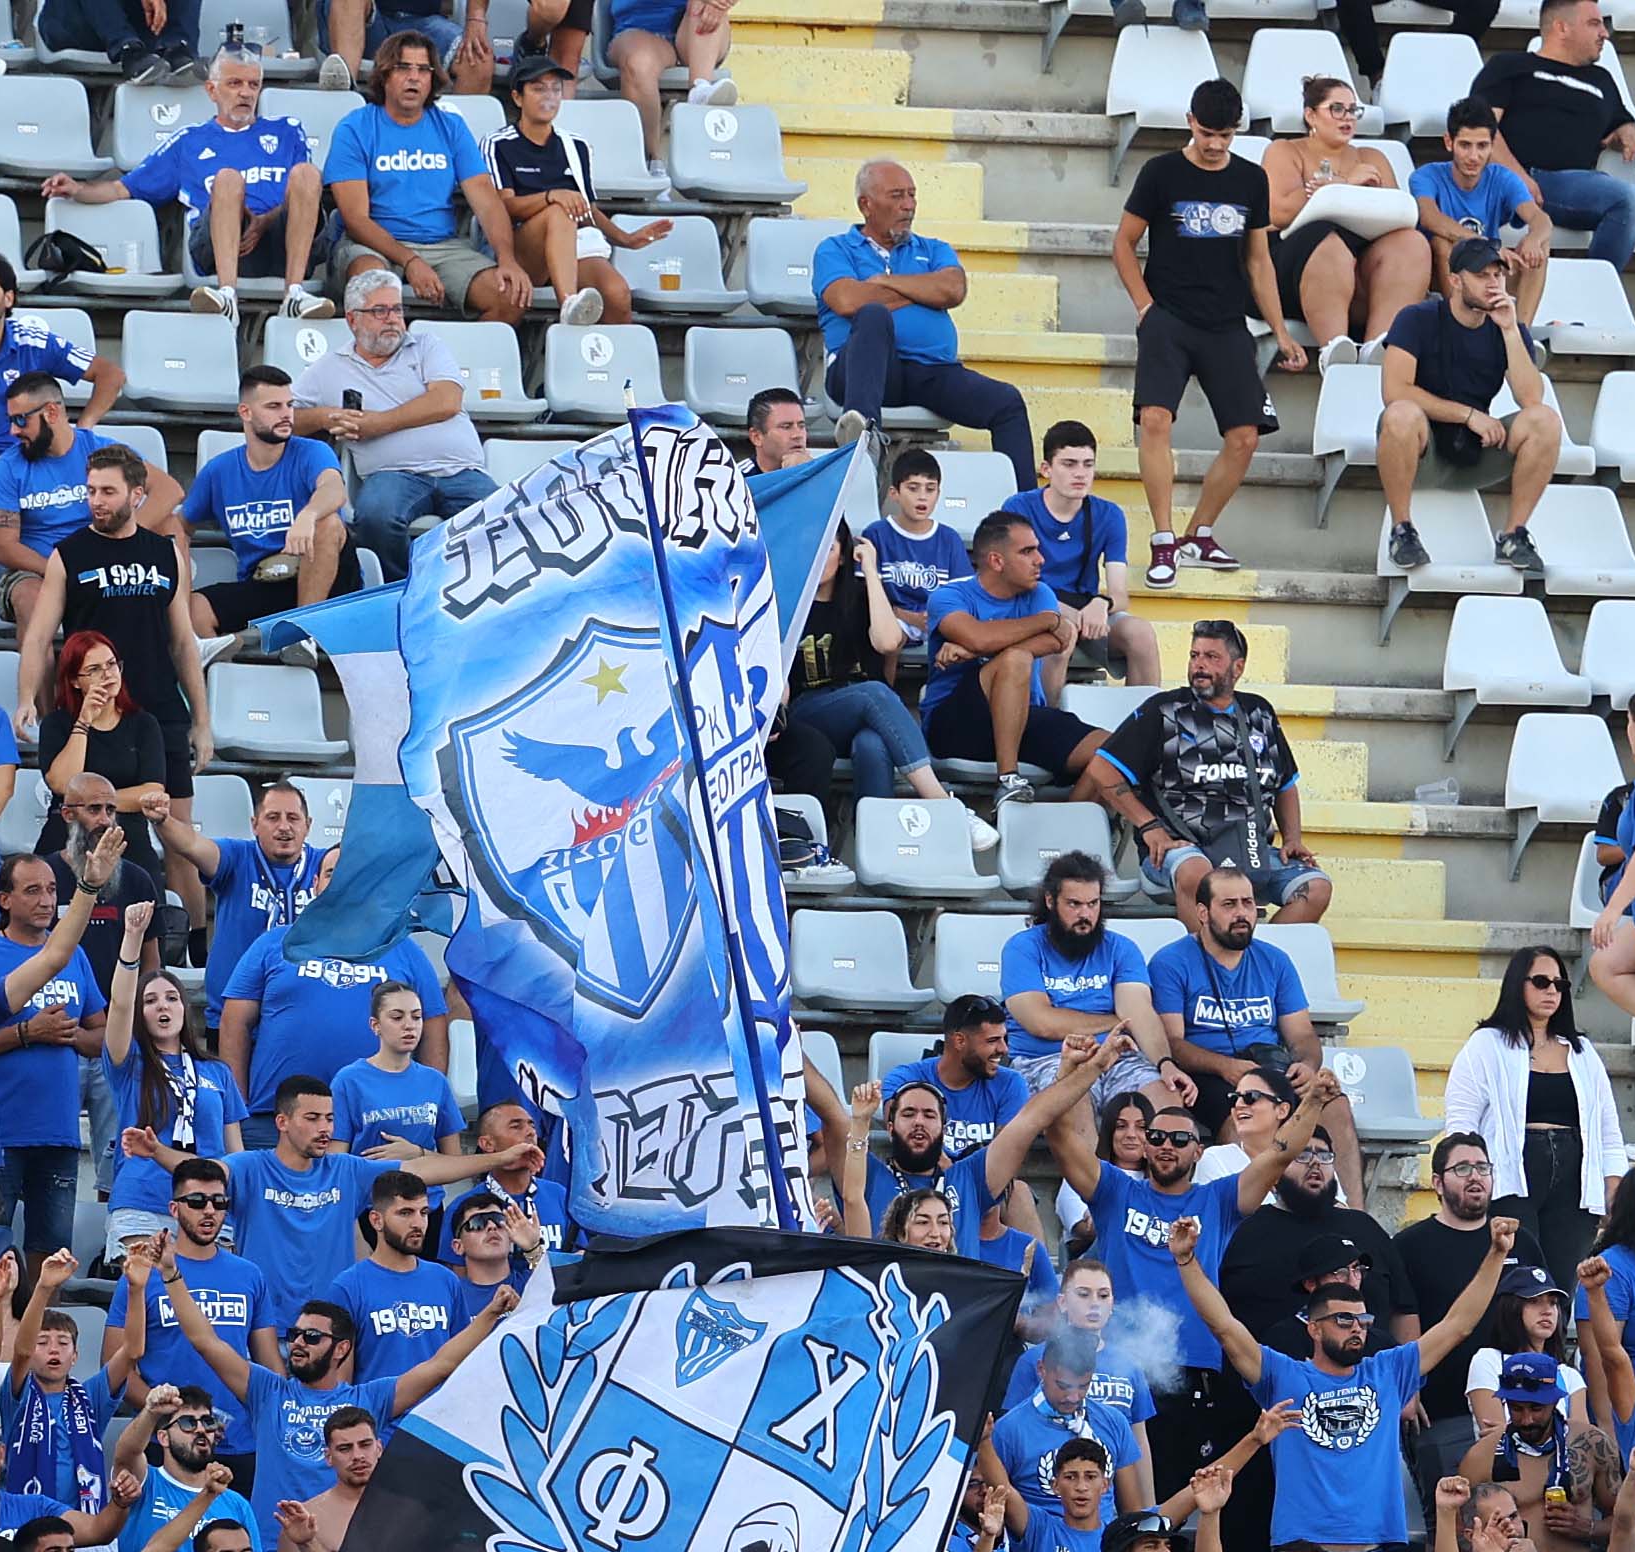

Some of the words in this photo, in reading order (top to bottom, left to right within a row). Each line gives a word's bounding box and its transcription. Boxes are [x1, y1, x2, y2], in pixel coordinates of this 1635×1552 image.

[376, 148, 447, 171] adidas
[96, 564, 160, 587] 1994
[1193, 764, 1273, 785] FONBT
[298, 961, 322, 977] 19
[354, 966, 387, 983] 94
[1125, 1208, 1149, 1237] 19
[163, 1302, 245, 1322] MHTEC
[370, 1311, 395, 1336] 19
[418, 1306, 449, 1331] 94
[577, 1438, 669, 1552] Φ
